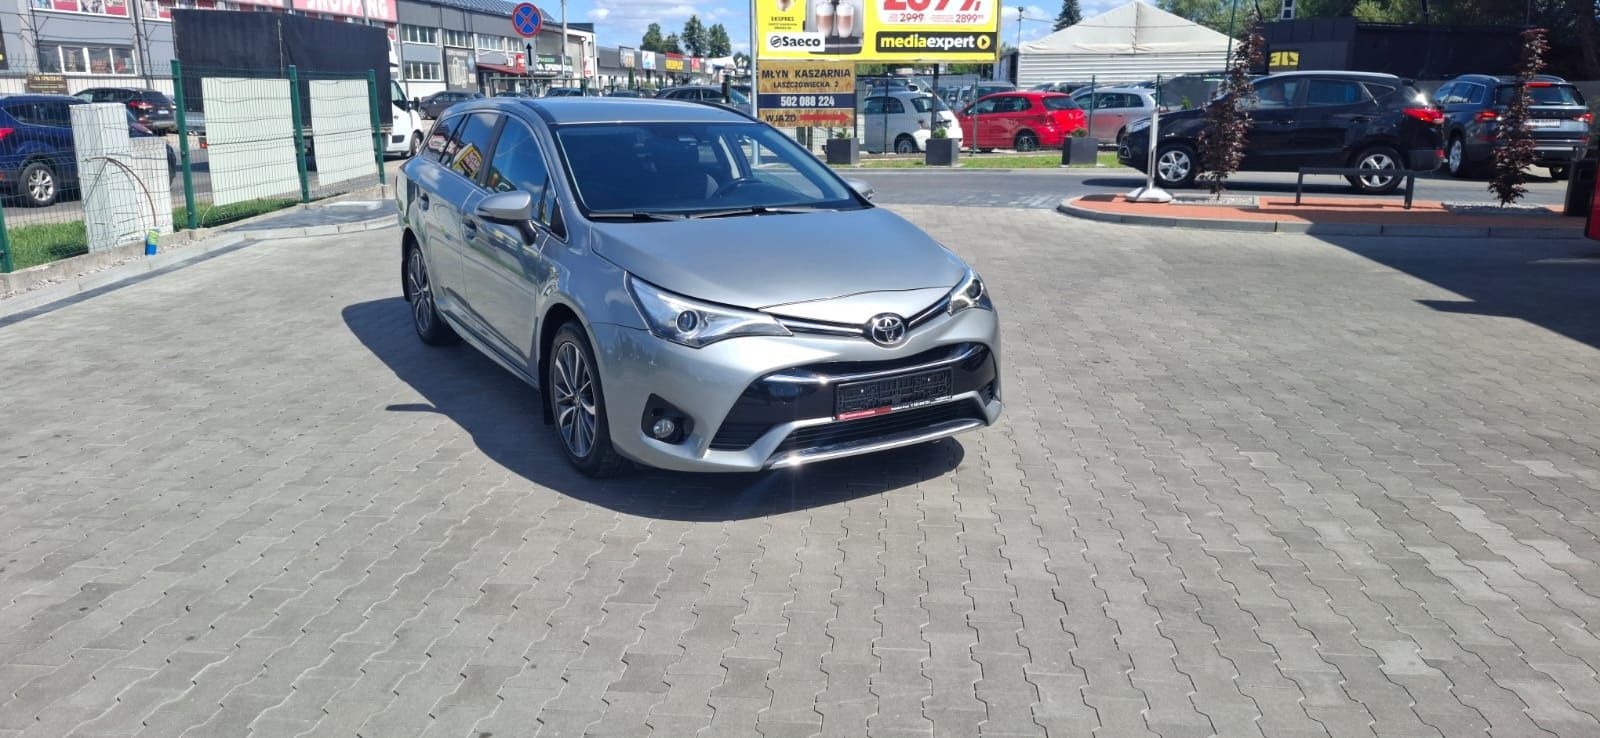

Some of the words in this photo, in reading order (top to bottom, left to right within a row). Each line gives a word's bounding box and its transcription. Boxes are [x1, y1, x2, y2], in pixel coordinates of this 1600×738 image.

[782, 36, 821, 47] Saeco
[880, 33, 975, 50] mediaexpert
[762, 70, 788, 78] MŁYN
[795, 69, 851, 78] KASZARNIA
[780, 96, 797, 106] 502
[799, 96, 816, 106] 088
[818, 96, 835, 106] 224
[766, 114, 796, 122] WJAZD
